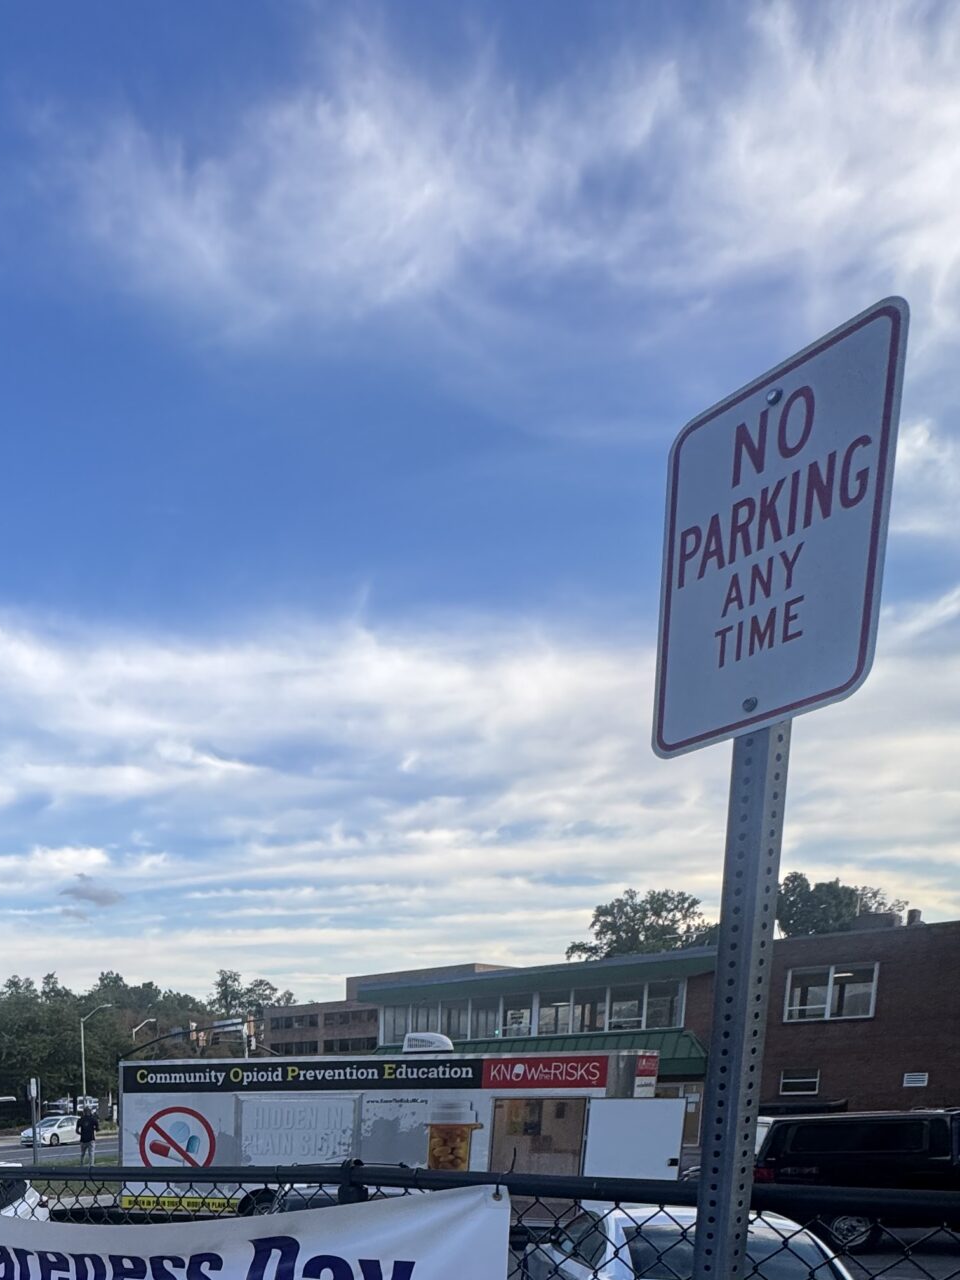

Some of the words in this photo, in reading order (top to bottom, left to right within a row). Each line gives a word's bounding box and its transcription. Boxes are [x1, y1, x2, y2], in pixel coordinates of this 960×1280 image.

[731, 385, 815, 488] NO
[677, 434, 873, 589] PARKING
[720, 541, 805, 617] ANY
[714, 595, 805, 668] TIME
[136, 1069, 226, 1086] Community
[230, 1067, 282, 1085] Opioid
[286, 1065, 378, 1080] Prevention
[383, 1063, 473, 1079] Education
[551, 1062, 600, 1081] RISKS
[254, 1106, 318, 1130] HIDDEN
[324, 1105, 344, 1130] IN
